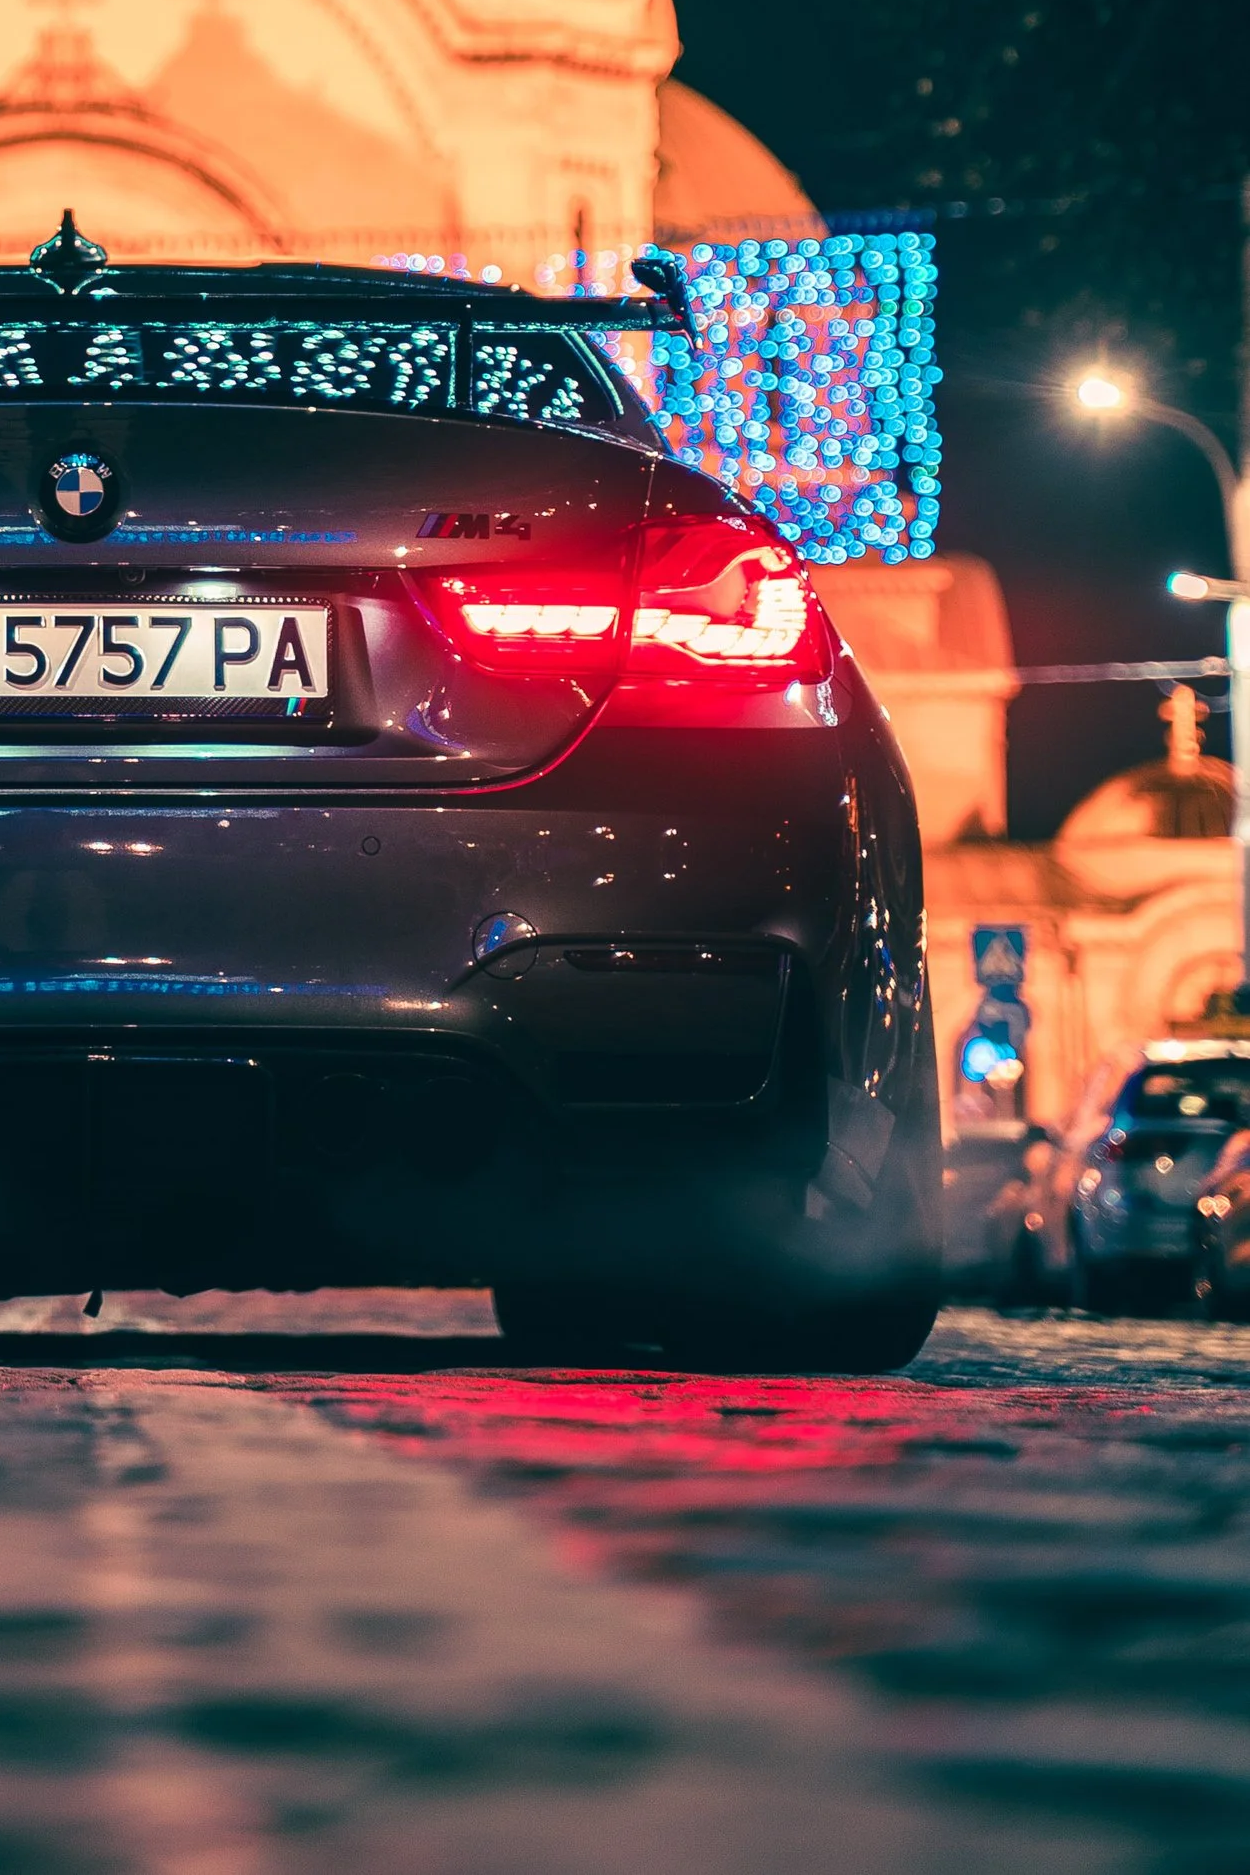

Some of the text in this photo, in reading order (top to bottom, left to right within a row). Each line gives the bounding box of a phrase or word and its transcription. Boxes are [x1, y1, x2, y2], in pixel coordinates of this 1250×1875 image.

[49, 453, 112, 479] BMW
[447, 513, 531, 540] M4
[5, 616, 192, 690] 5757
[214, 617, 316, 691] PA
